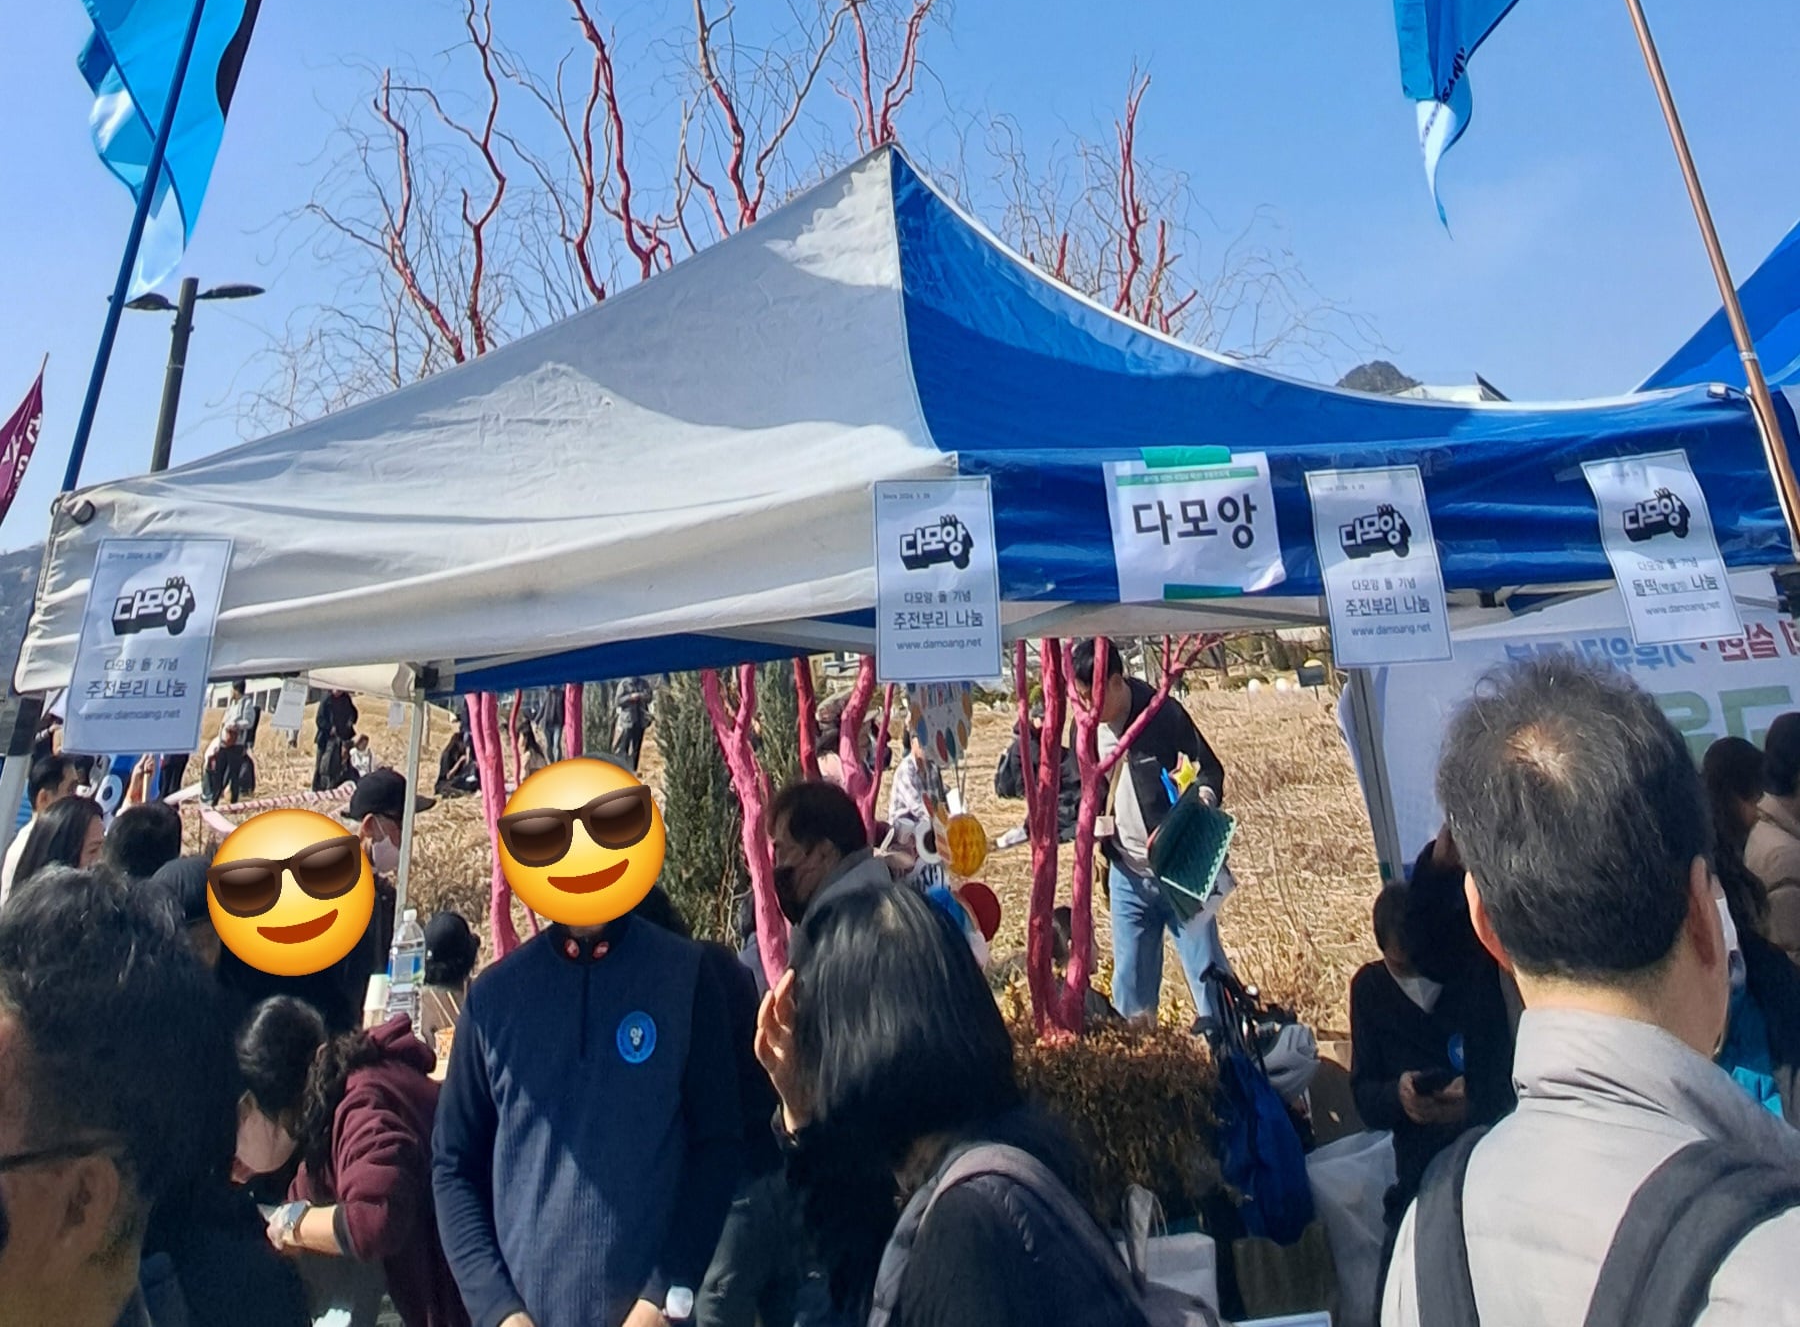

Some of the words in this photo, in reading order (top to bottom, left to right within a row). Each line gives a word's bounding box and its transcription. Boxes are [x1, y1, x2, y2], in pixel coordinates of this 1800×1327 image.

[1132, 493, 1257, 549] 다모앙
[1624, 495, 1683, 531] 다모앙
[900, 520, 967, 557] 다모앙
[1339, 511, 1405, 547] 다모앙
[1691, 574, 1719, 591] 나눔
[113, 582, 193, 624] 다모앙
[904, 591, 933, 604] 다모앙
[953, 590, 972, 603] 기념
[1345, 598, 1399, 617] 주전부리
[1405, 596, 1432, 614] 나눔
[893, 611, 949, 629] 주전부리
[956, 610, 984, 628] 나눔
[1351, 622, 1432, 637] www.damoang.net
[896, 637, 982, 651] www.damoang.net
[157, 657, 179, 672] 기념
[86, 679, 149, 699] 주전부리
[156, 678, 188, 698] 나눔
